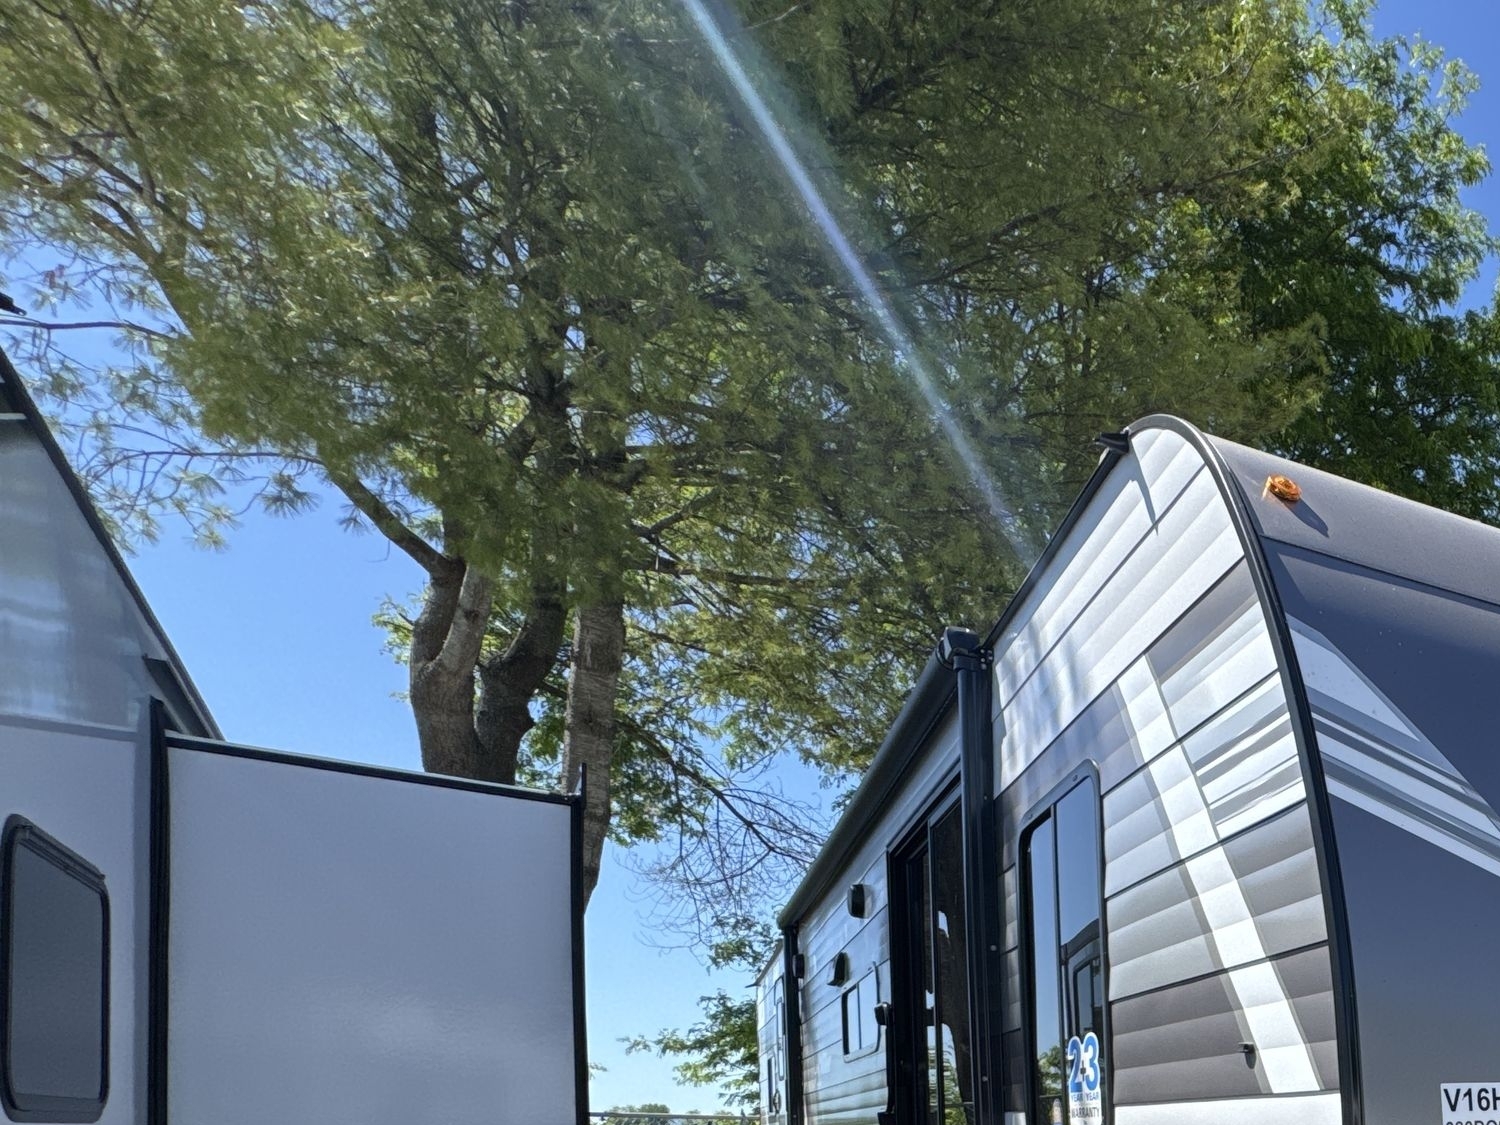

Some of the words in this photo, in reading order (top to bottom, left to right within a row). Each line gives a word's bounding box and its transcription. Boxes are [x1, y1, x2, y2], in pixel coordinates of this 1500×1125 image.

[1070, 1092, 1084, 1102] YEAR
[1085, 1091, 1100, 1101] YEAR
[1071, 1106, 1100, 1119] WARRANTY
